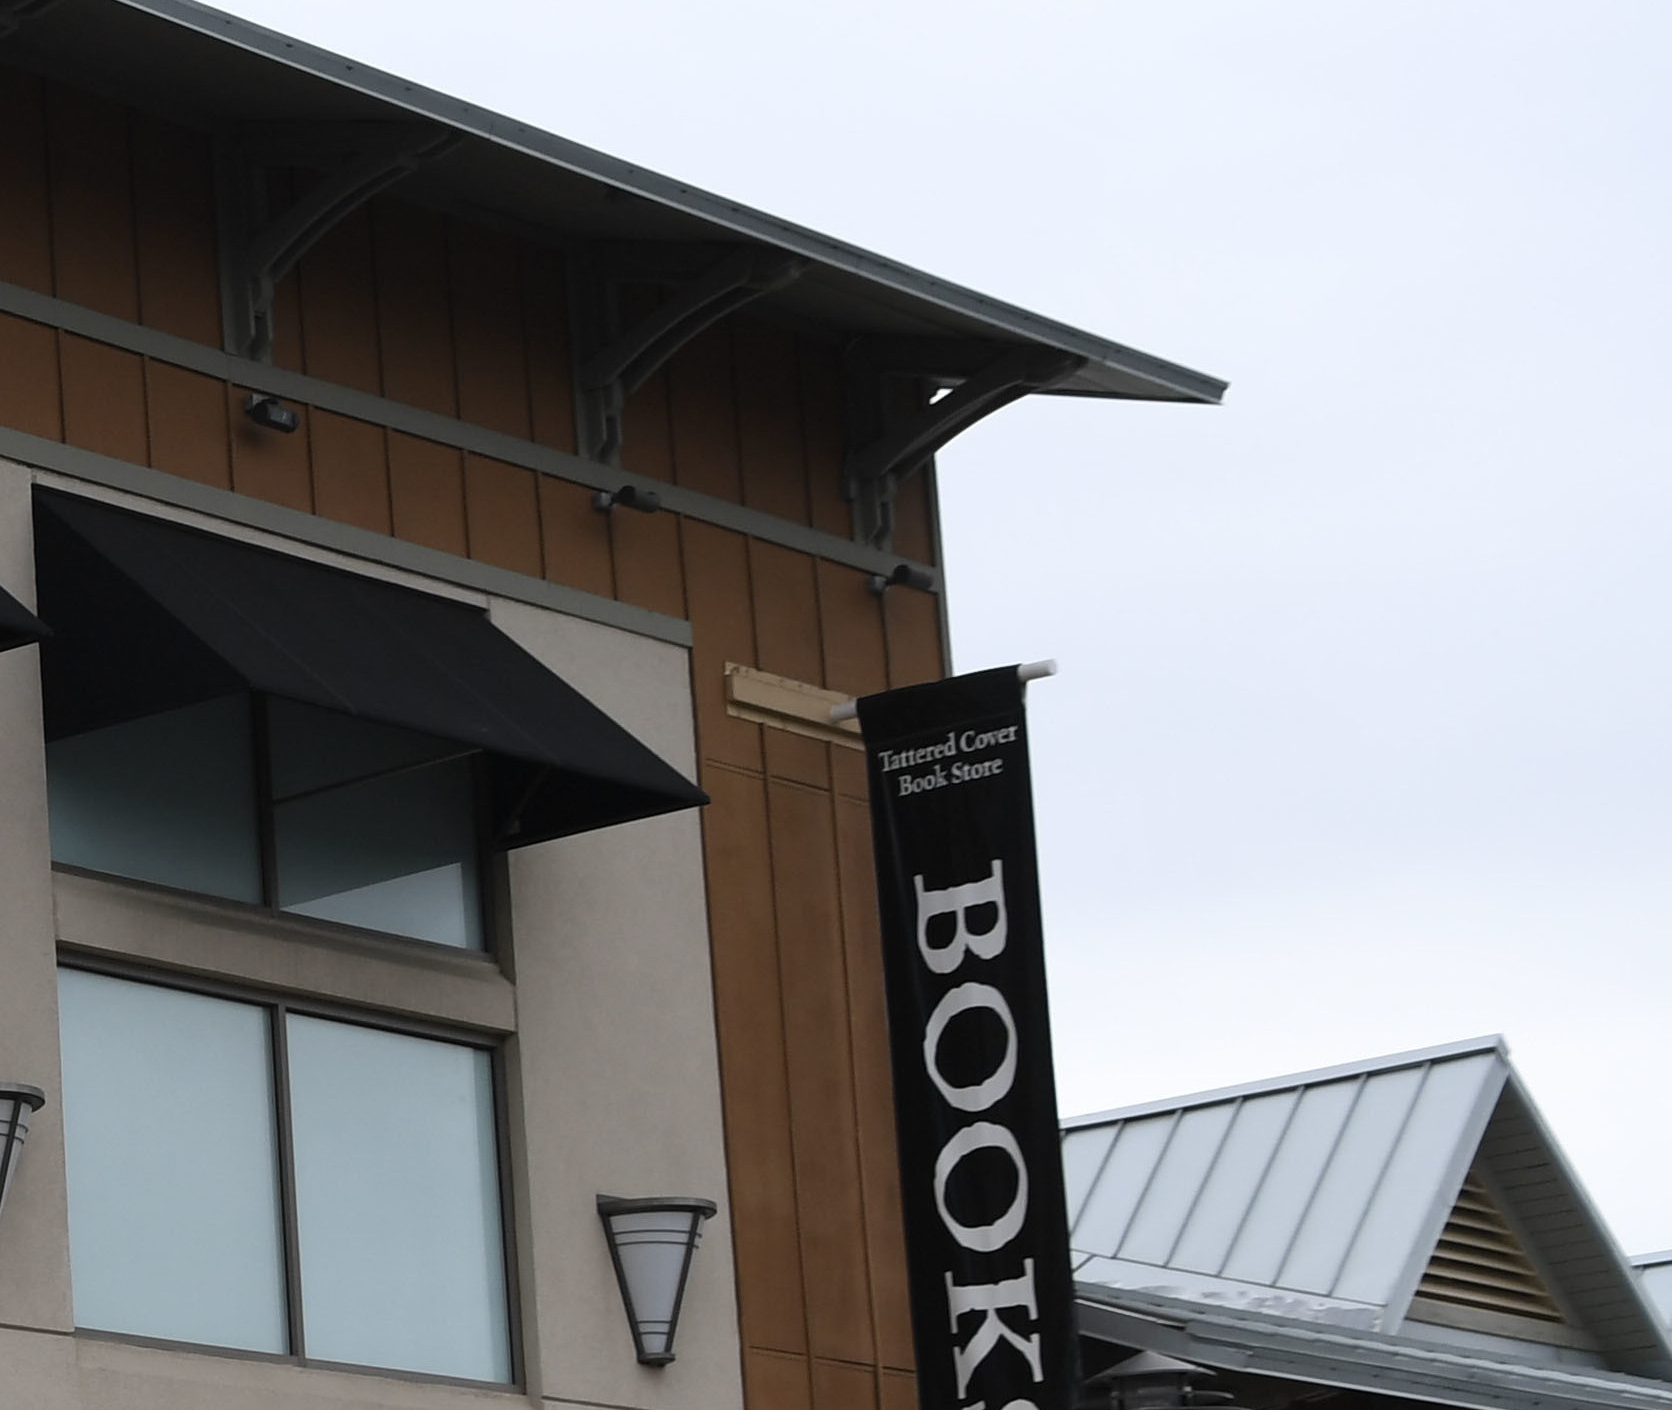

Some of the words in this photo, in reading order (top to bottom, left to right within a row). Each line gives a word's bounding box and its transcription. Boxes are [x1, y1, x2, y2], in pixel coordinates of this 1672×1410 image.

[877, 732, 956, 772] Tattered
[959, 725, 1018, 752] Cover
[899, 764, 948, 796] Book
[951, 757, 1004, 783] Store
